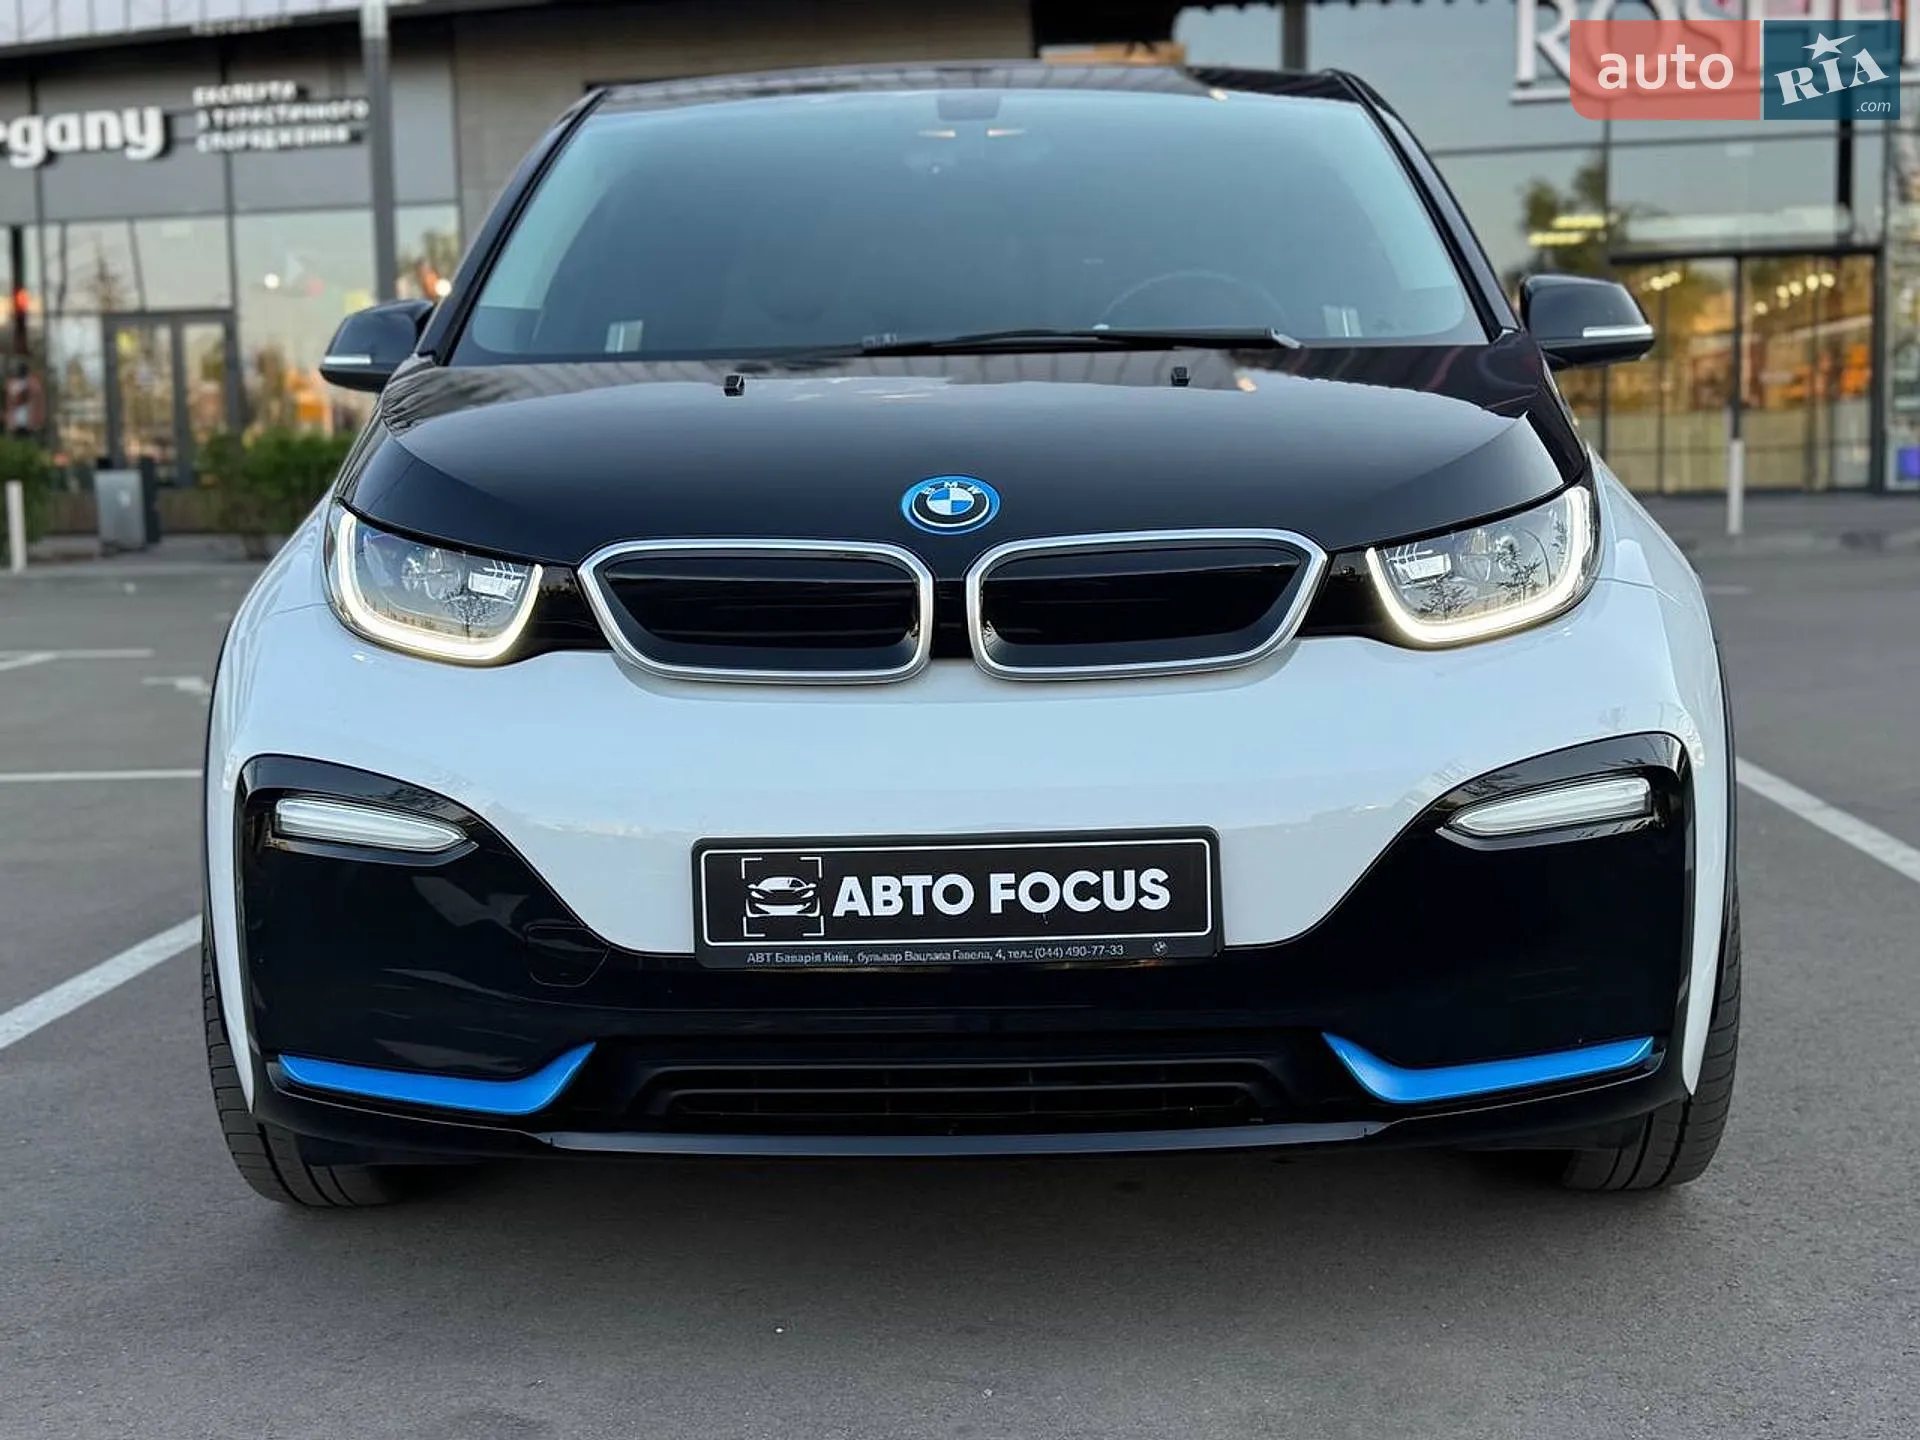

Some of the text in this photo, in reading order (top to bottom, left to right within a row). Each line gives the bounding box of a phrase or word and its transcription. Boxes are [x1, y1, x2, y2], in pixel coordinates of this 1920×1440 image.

[0, 106, 165, 169] gany
[832, 867, 1170, 918] АВТО FOCUS
[747, 952, 772, 964] АВТ
[775, 952, 822, 965] Баварія
[1034, 946, 1063, 960] (044)
[1065, 944, 1124, 957] 490-77-33
